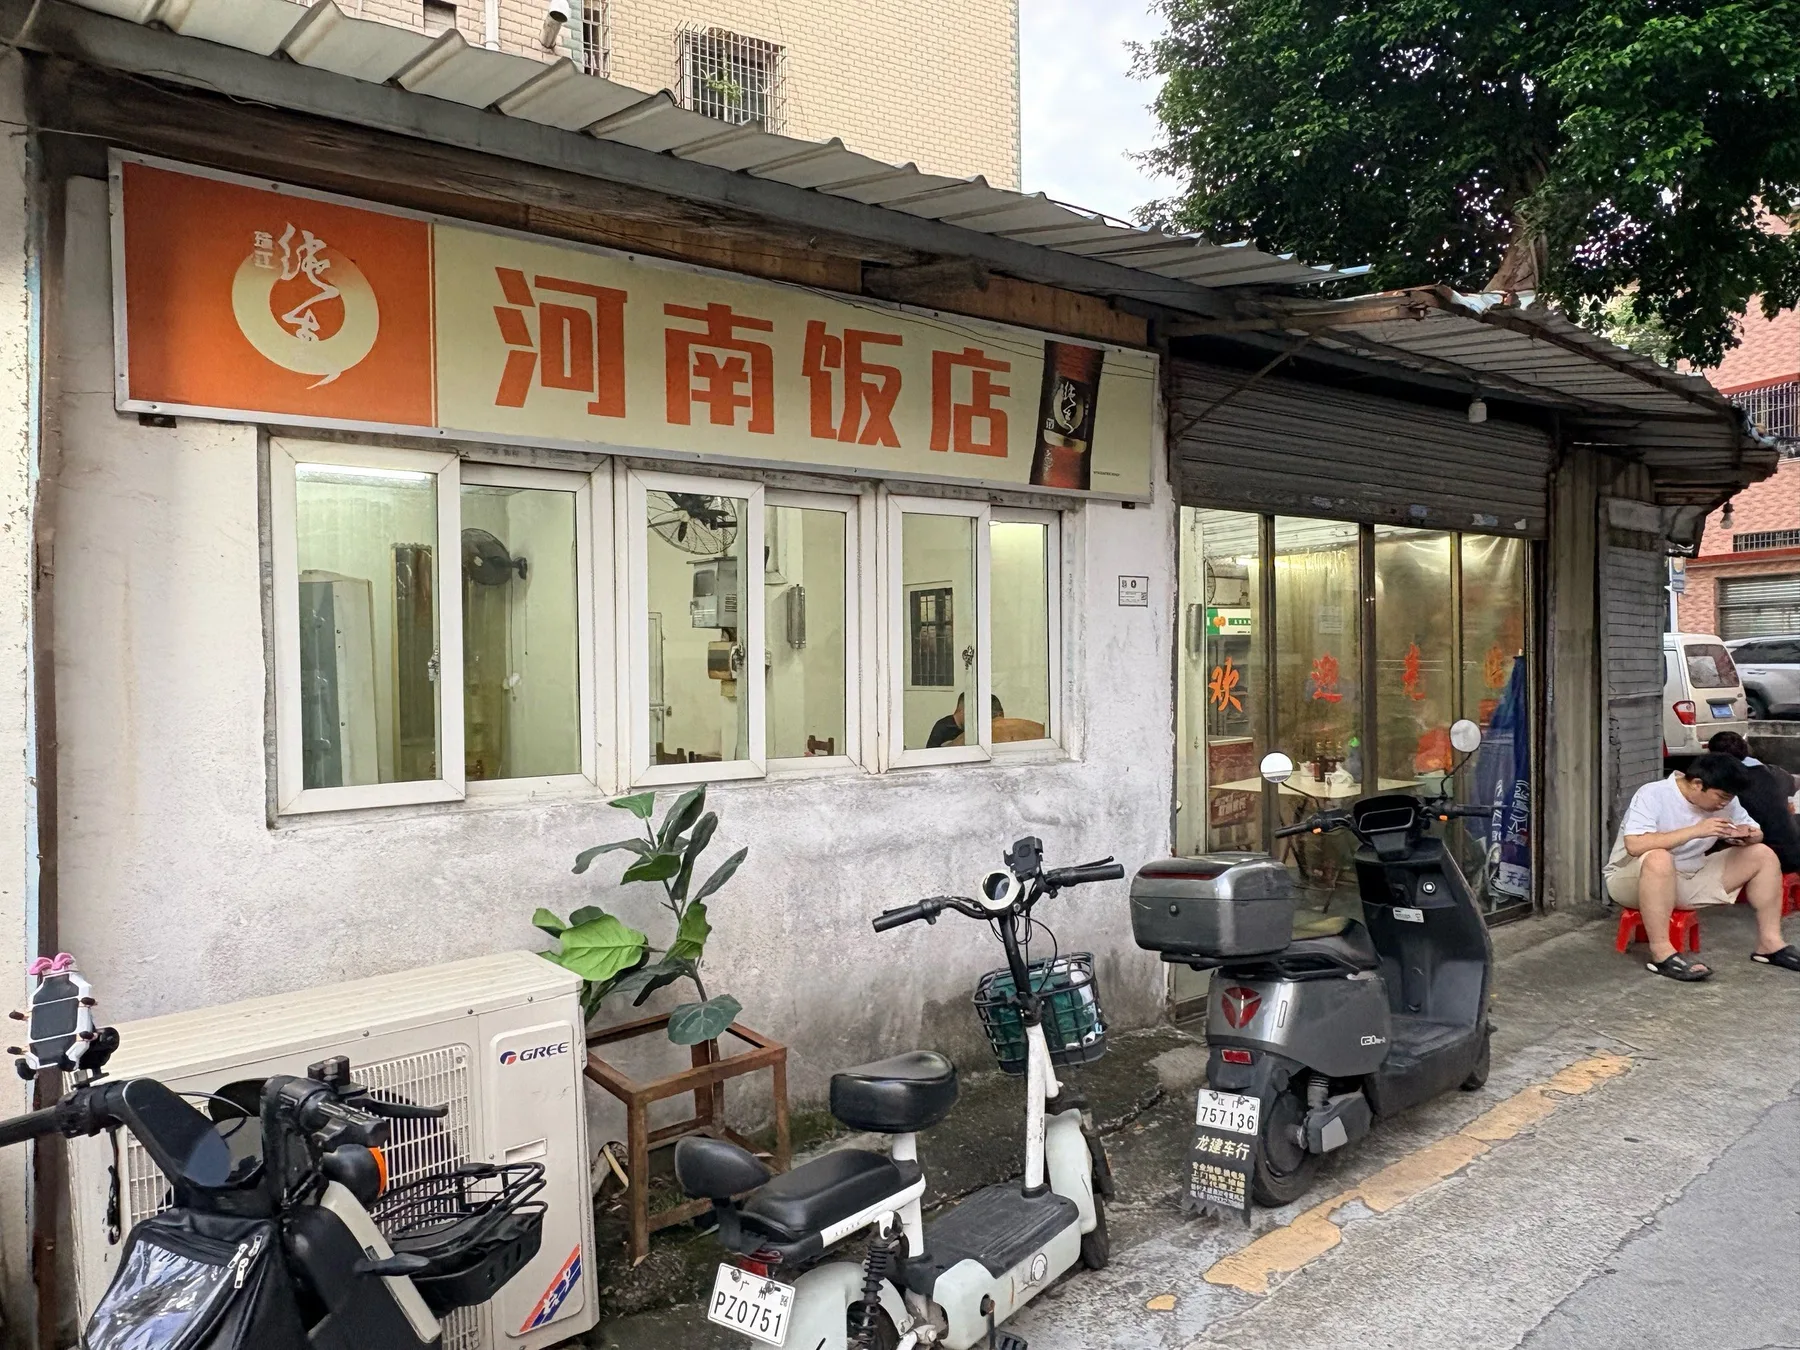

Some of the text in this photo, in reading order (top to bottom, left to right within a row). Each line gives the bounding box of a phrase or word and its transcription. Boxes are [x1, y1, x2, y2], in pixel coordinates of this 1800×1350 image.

[494, 266, 1011, 458] 河南饭店
[519, 1041, 570, 1062] GREE
[1201, 1106, 1255, 1130] 757136
[1195, 1134, 1250, 1161] 龙建车行
[739, 1280, 768, 1300] 广州
[714, 1291, 782, 1337] PZ0751
